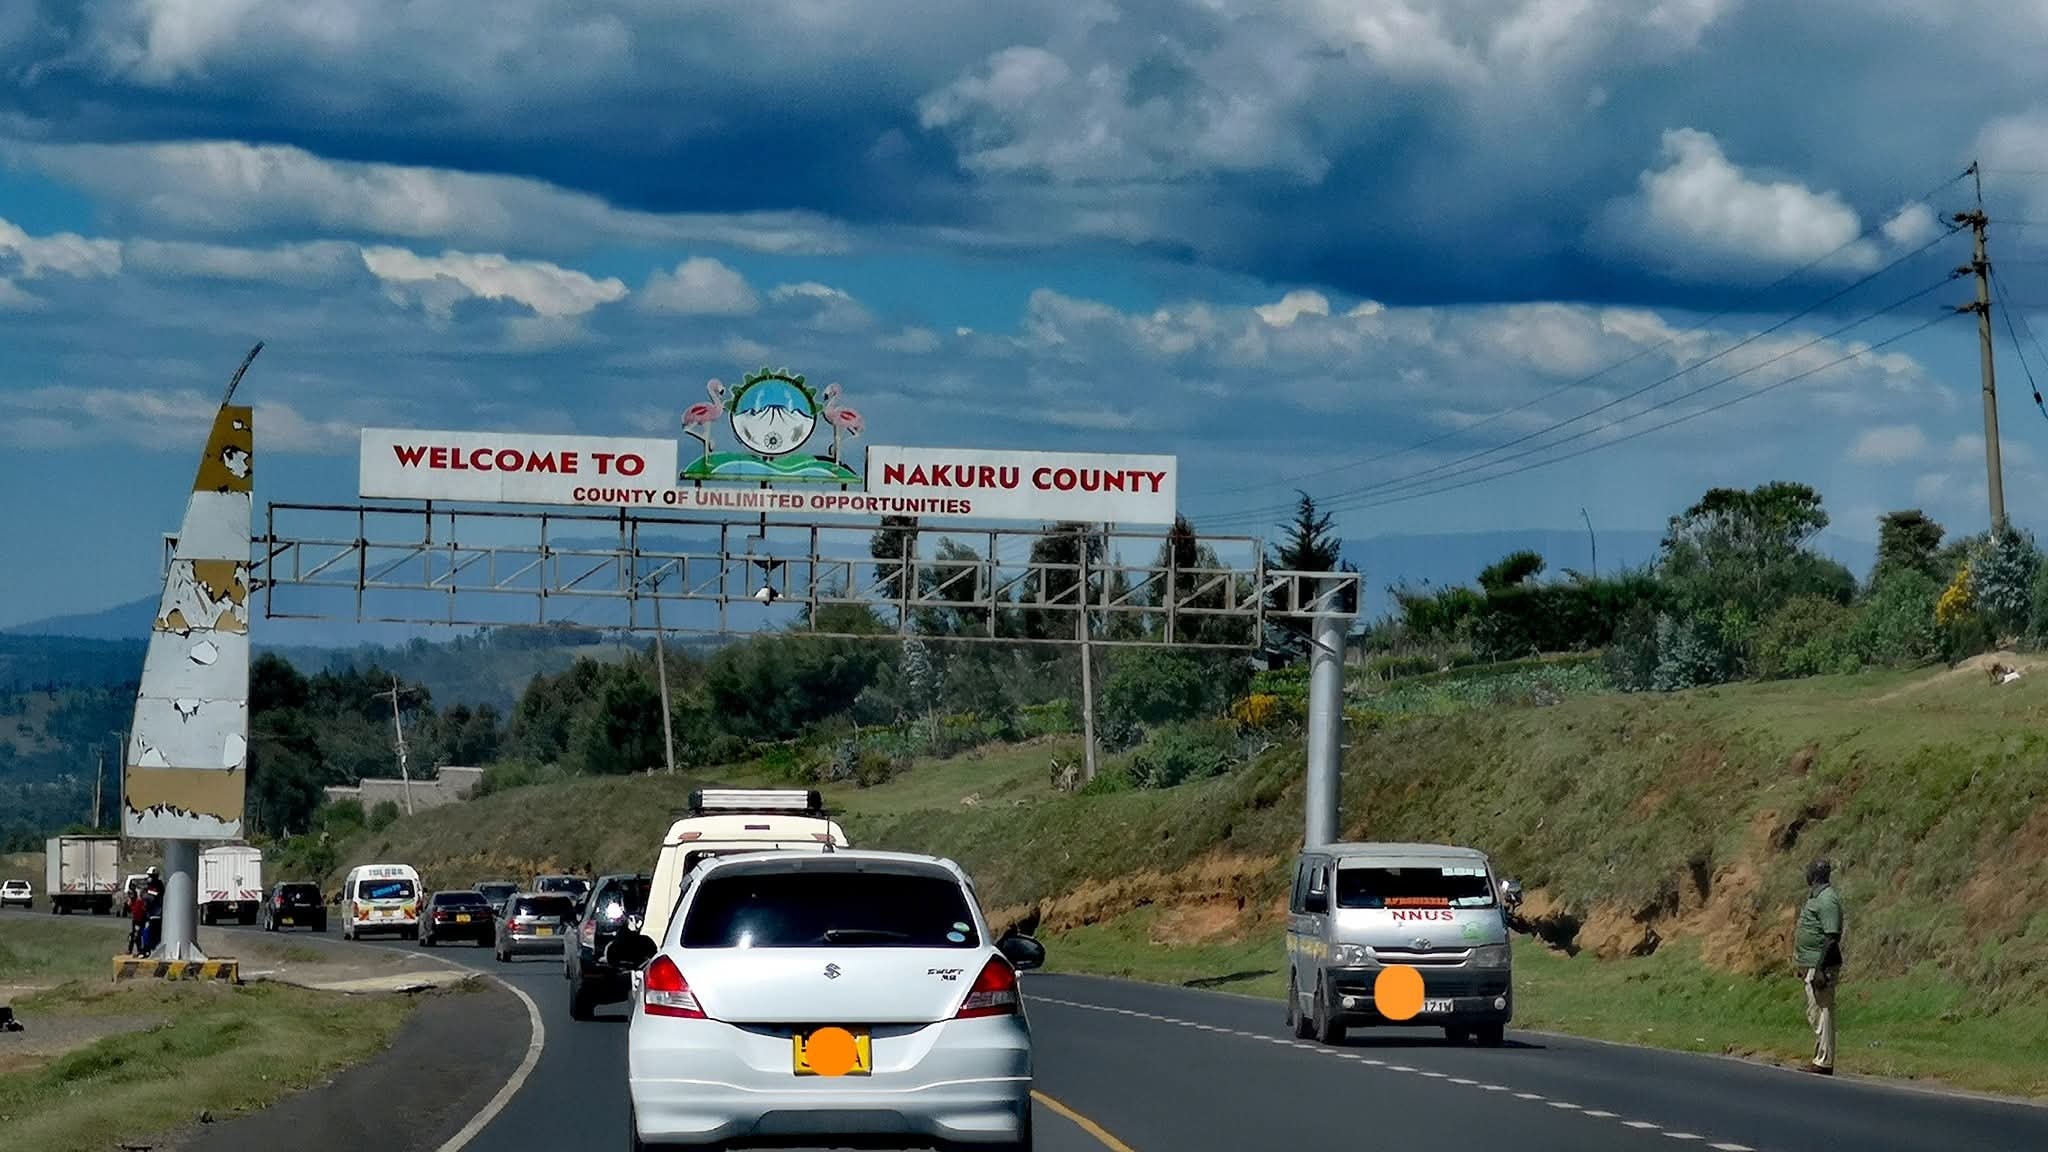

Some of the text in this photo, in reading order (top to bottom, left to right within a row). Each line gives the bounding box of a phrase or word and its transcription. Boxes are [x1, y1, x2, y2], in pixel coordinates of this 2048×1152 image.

[393, 445, 645, 476] WELCOME TO
[884, 463, 1167, 493] NAKURU COUNTY
[573, 487, 971, 514] COUNTY OF UNLIMITED OPPORTUNITIES
[1392, 910, 1454, 921] NNUS
